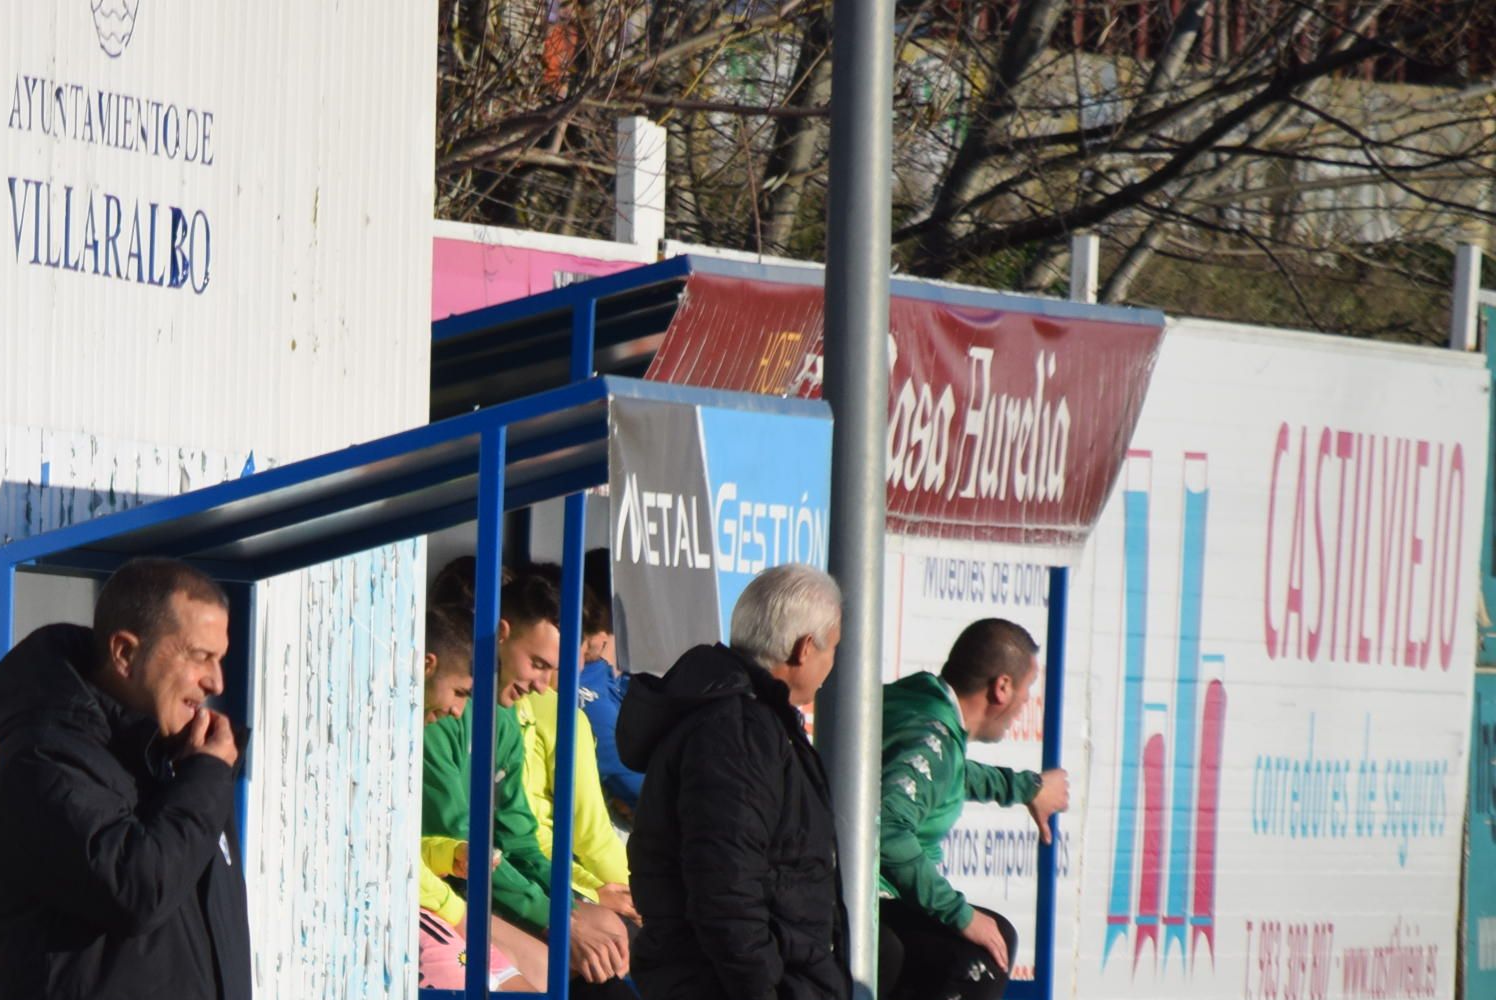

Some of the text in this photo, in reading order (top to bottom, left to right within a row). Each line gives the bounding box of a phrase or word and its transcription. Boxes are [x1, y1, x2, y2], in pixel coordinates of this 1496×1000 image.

[8, 72, 214, 166] AYUNTAMIENTO DE
[7, 176, 211, 295] VILLARALBO
[886, 333, 1071, 504] asa Aurelia
[616, 472, 828, 574] METAL GESTIÓN
[1264, 420, 1466, 672] CASTILVIEJO
[1252, 712, 1349, 839] corredores
[1356, 712, 1377, 838] de
[1381, 759, 1448, 868] seguros
